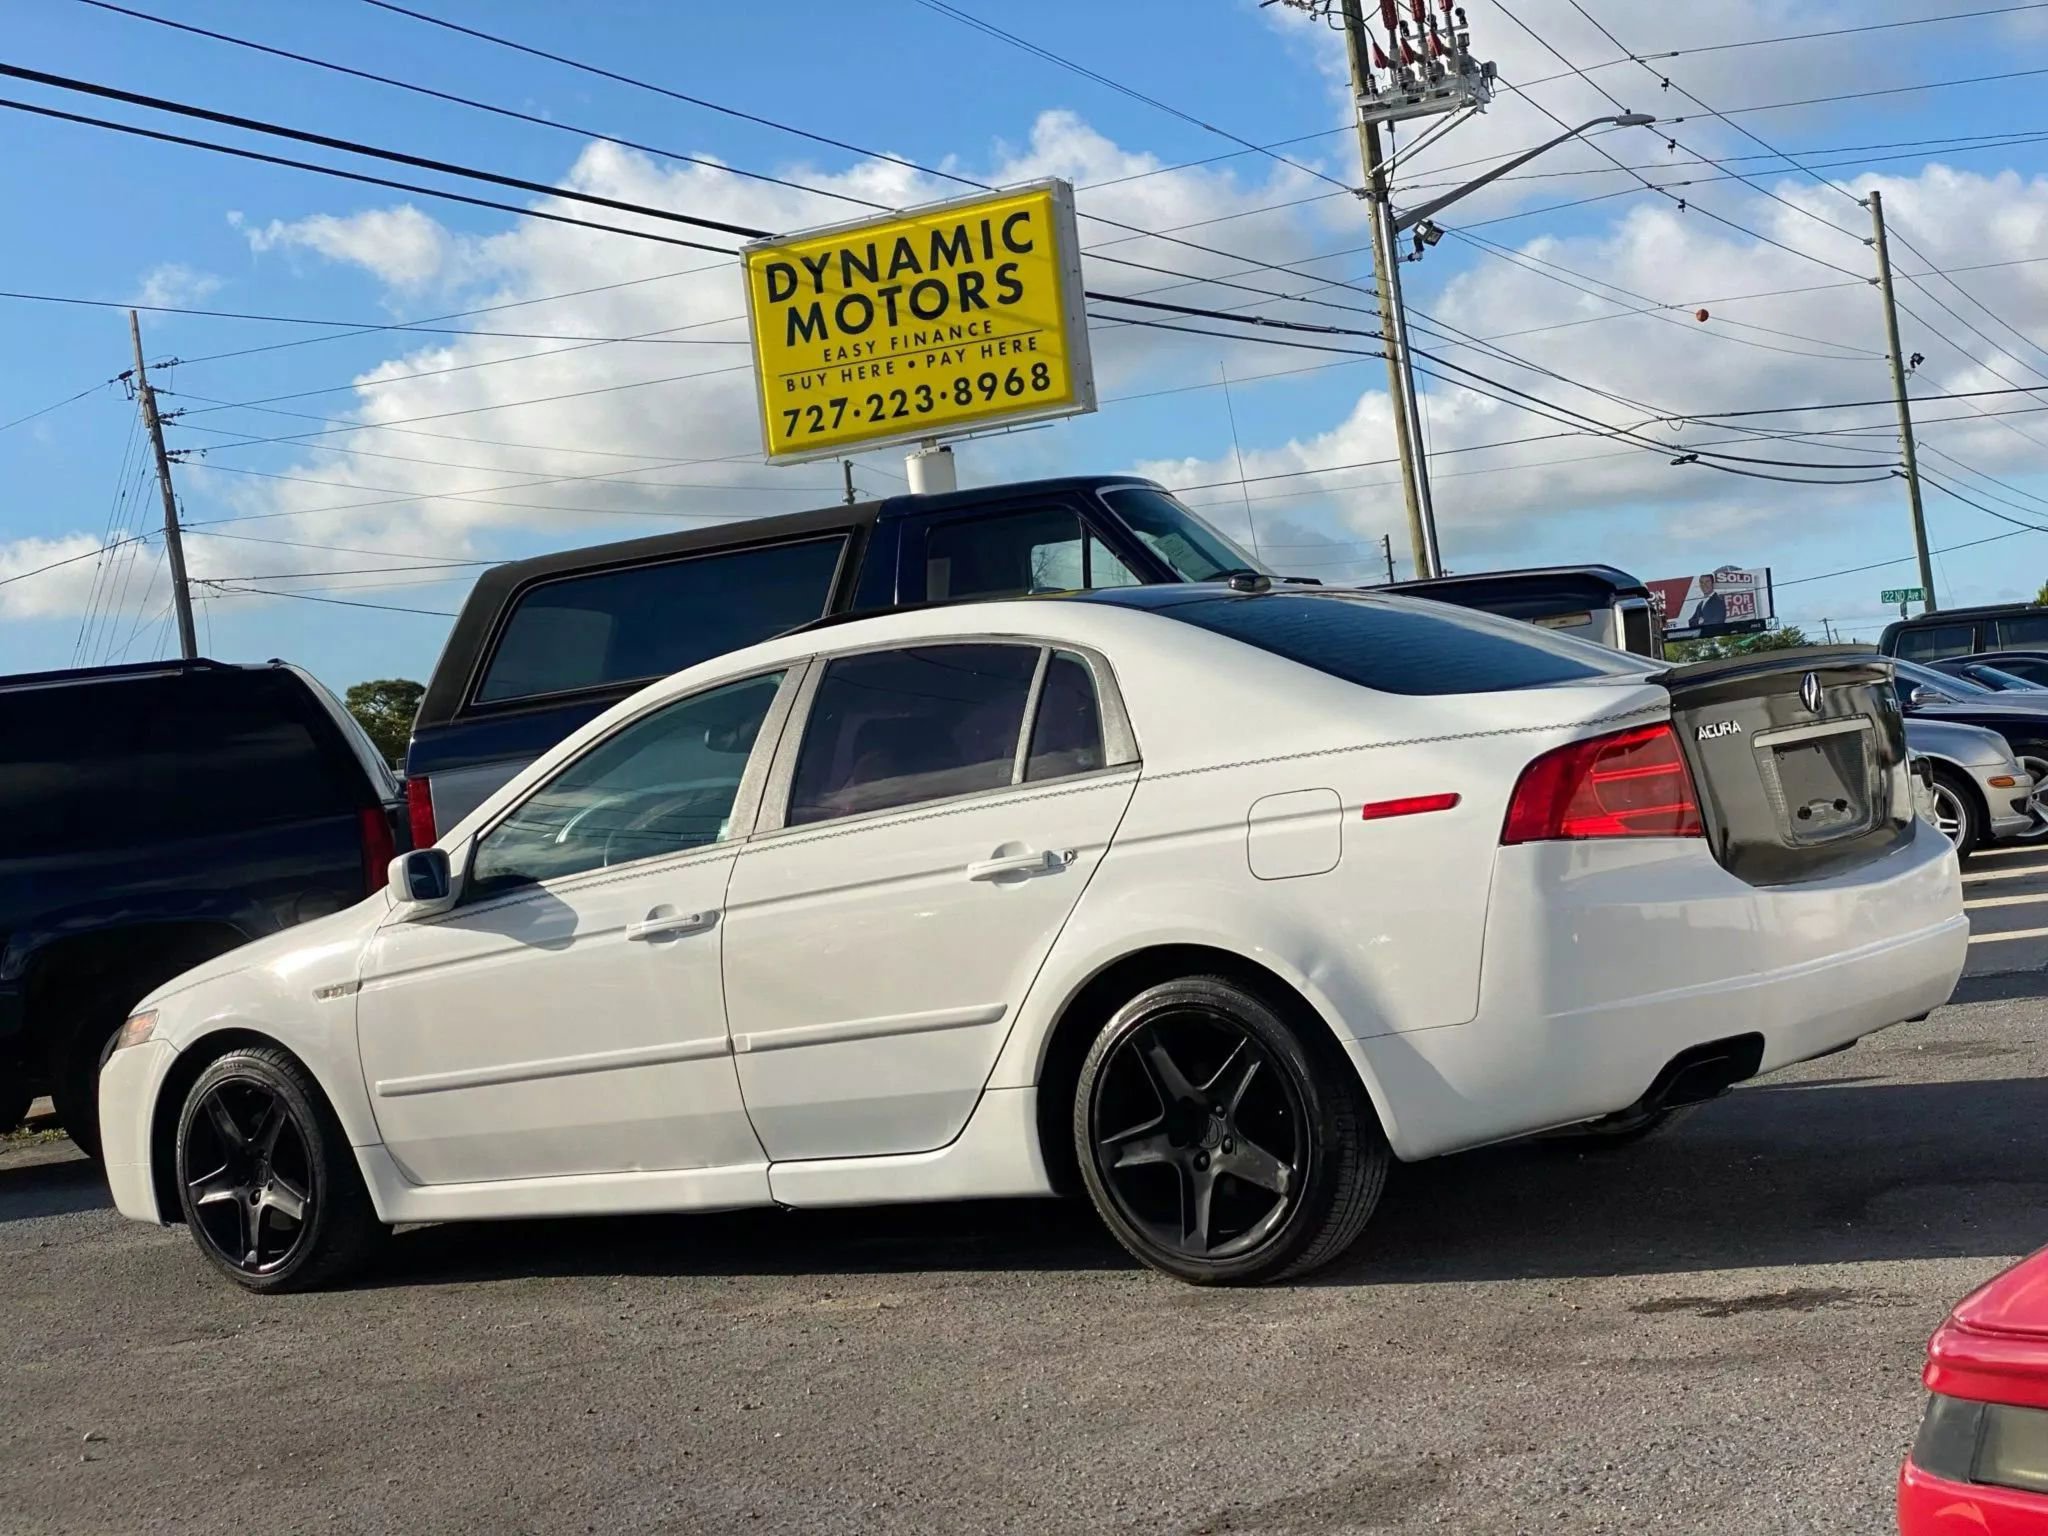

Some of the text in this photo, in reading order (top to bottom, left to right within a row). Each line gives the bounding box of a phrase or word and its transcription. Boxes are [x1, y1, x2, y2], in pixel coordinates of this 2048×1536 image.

[766, 211, 1034, 304] DYNAMIC
[786, 262, 1025, 347] MOTORS
[823, 320, 994, 363] EASY FINANCE
[786, 337, 1038, 392] BUY HERE PAY HERE
[1716, 572, 1751, 583] SOLD
[1724, 594, 1750, 606] FOR
[1697, 720, 1741, 740] ACURA
